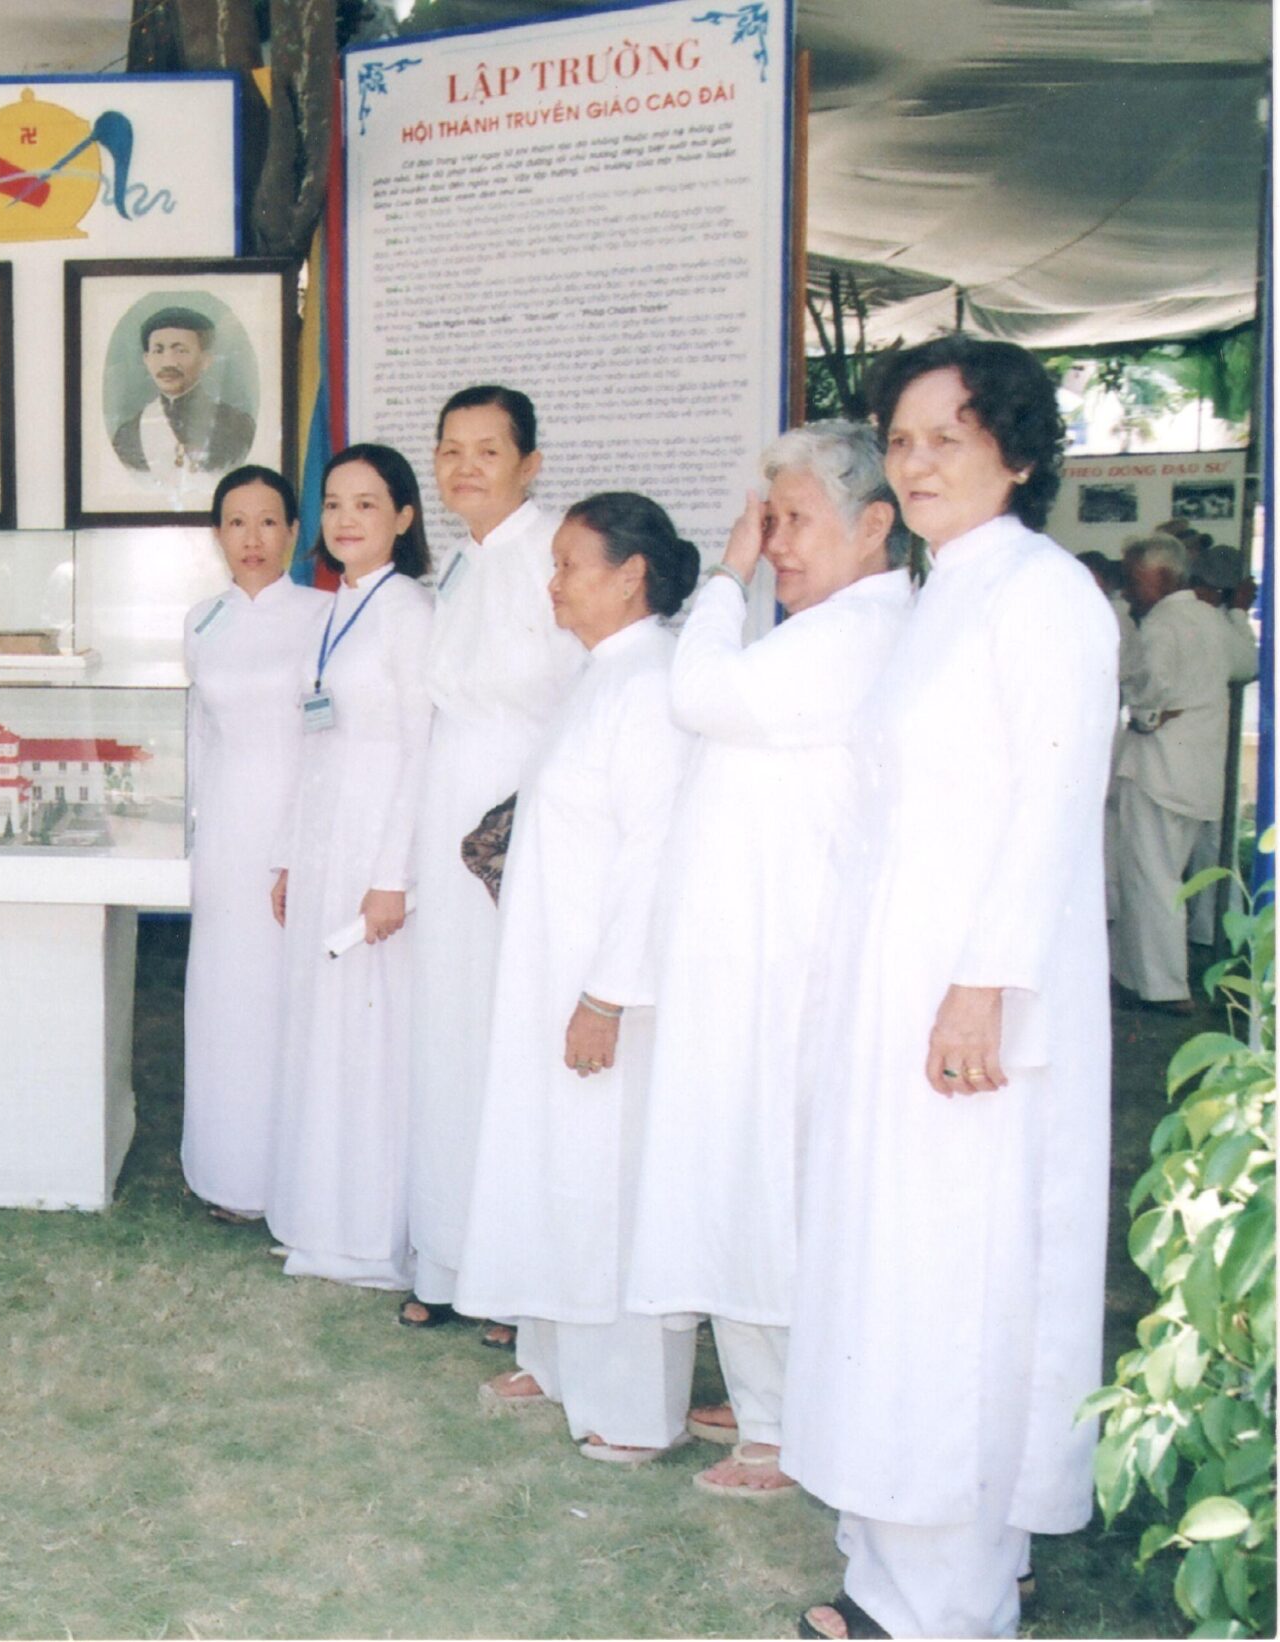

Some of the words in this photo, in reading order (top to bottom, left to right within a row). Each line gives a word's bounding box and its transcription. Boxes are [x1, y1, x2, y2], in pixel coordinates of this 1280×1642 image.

[447, 62, 520, 104] LẬP
[530, 38, 701, 91] TRƯỜNG
[402, 119, 432, 144] HỘI
[438, 115, 500, 138] THÁNH
[506, 100, 580, 129] TRUYỀN
[586, 94, 640, 119] GIÁO
[646, 89, 692, 112] CAO
[698, 80, 735, 104] ĐÀI
